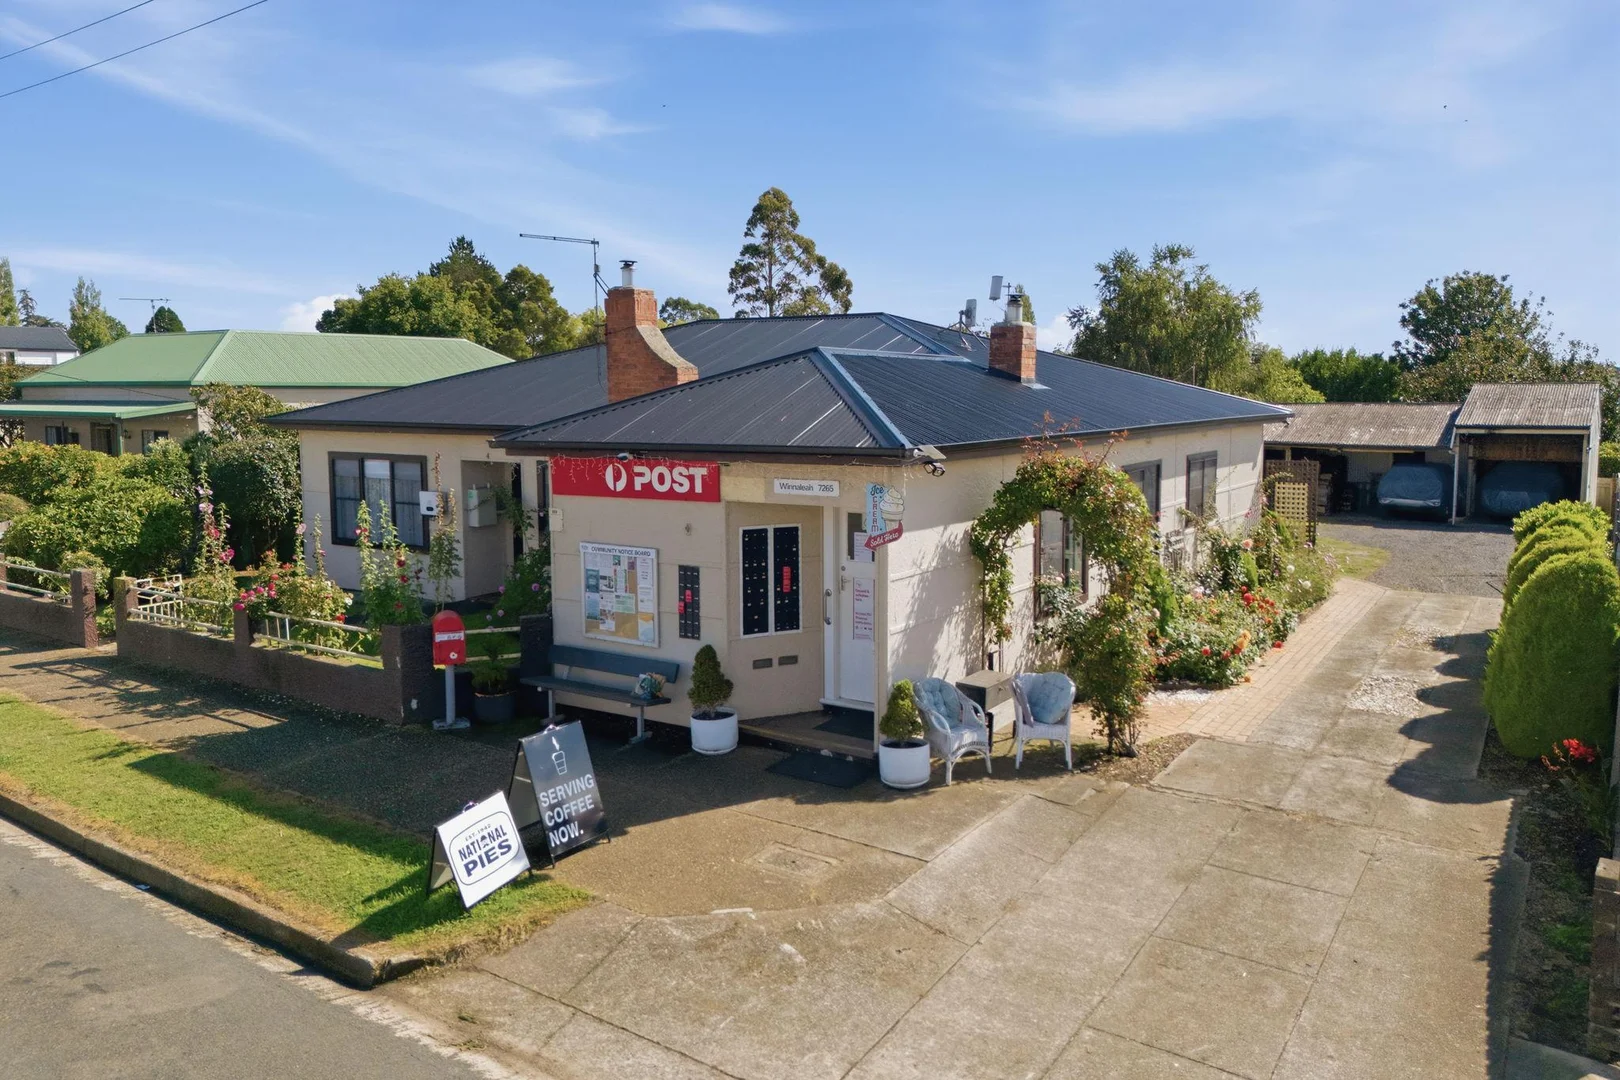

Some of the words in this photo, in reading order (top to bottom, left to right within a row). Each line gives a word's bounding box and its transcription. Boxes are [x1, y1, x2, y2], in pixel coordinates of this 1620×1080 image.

[633, 465, 707, 494] POST
[779, 482, 814, 491] Winnaleah
[817, 484, 835, 492] 7265
[870, 484, 884, 496] Ice
[870, 535, 884, 546] Sold
[539, 774, 594, 807] SERVING
[545, 794, 595, 827] COFFEE
[549, 820, 584, 847] NOW.
[463, 838, 512, 878] PIES
